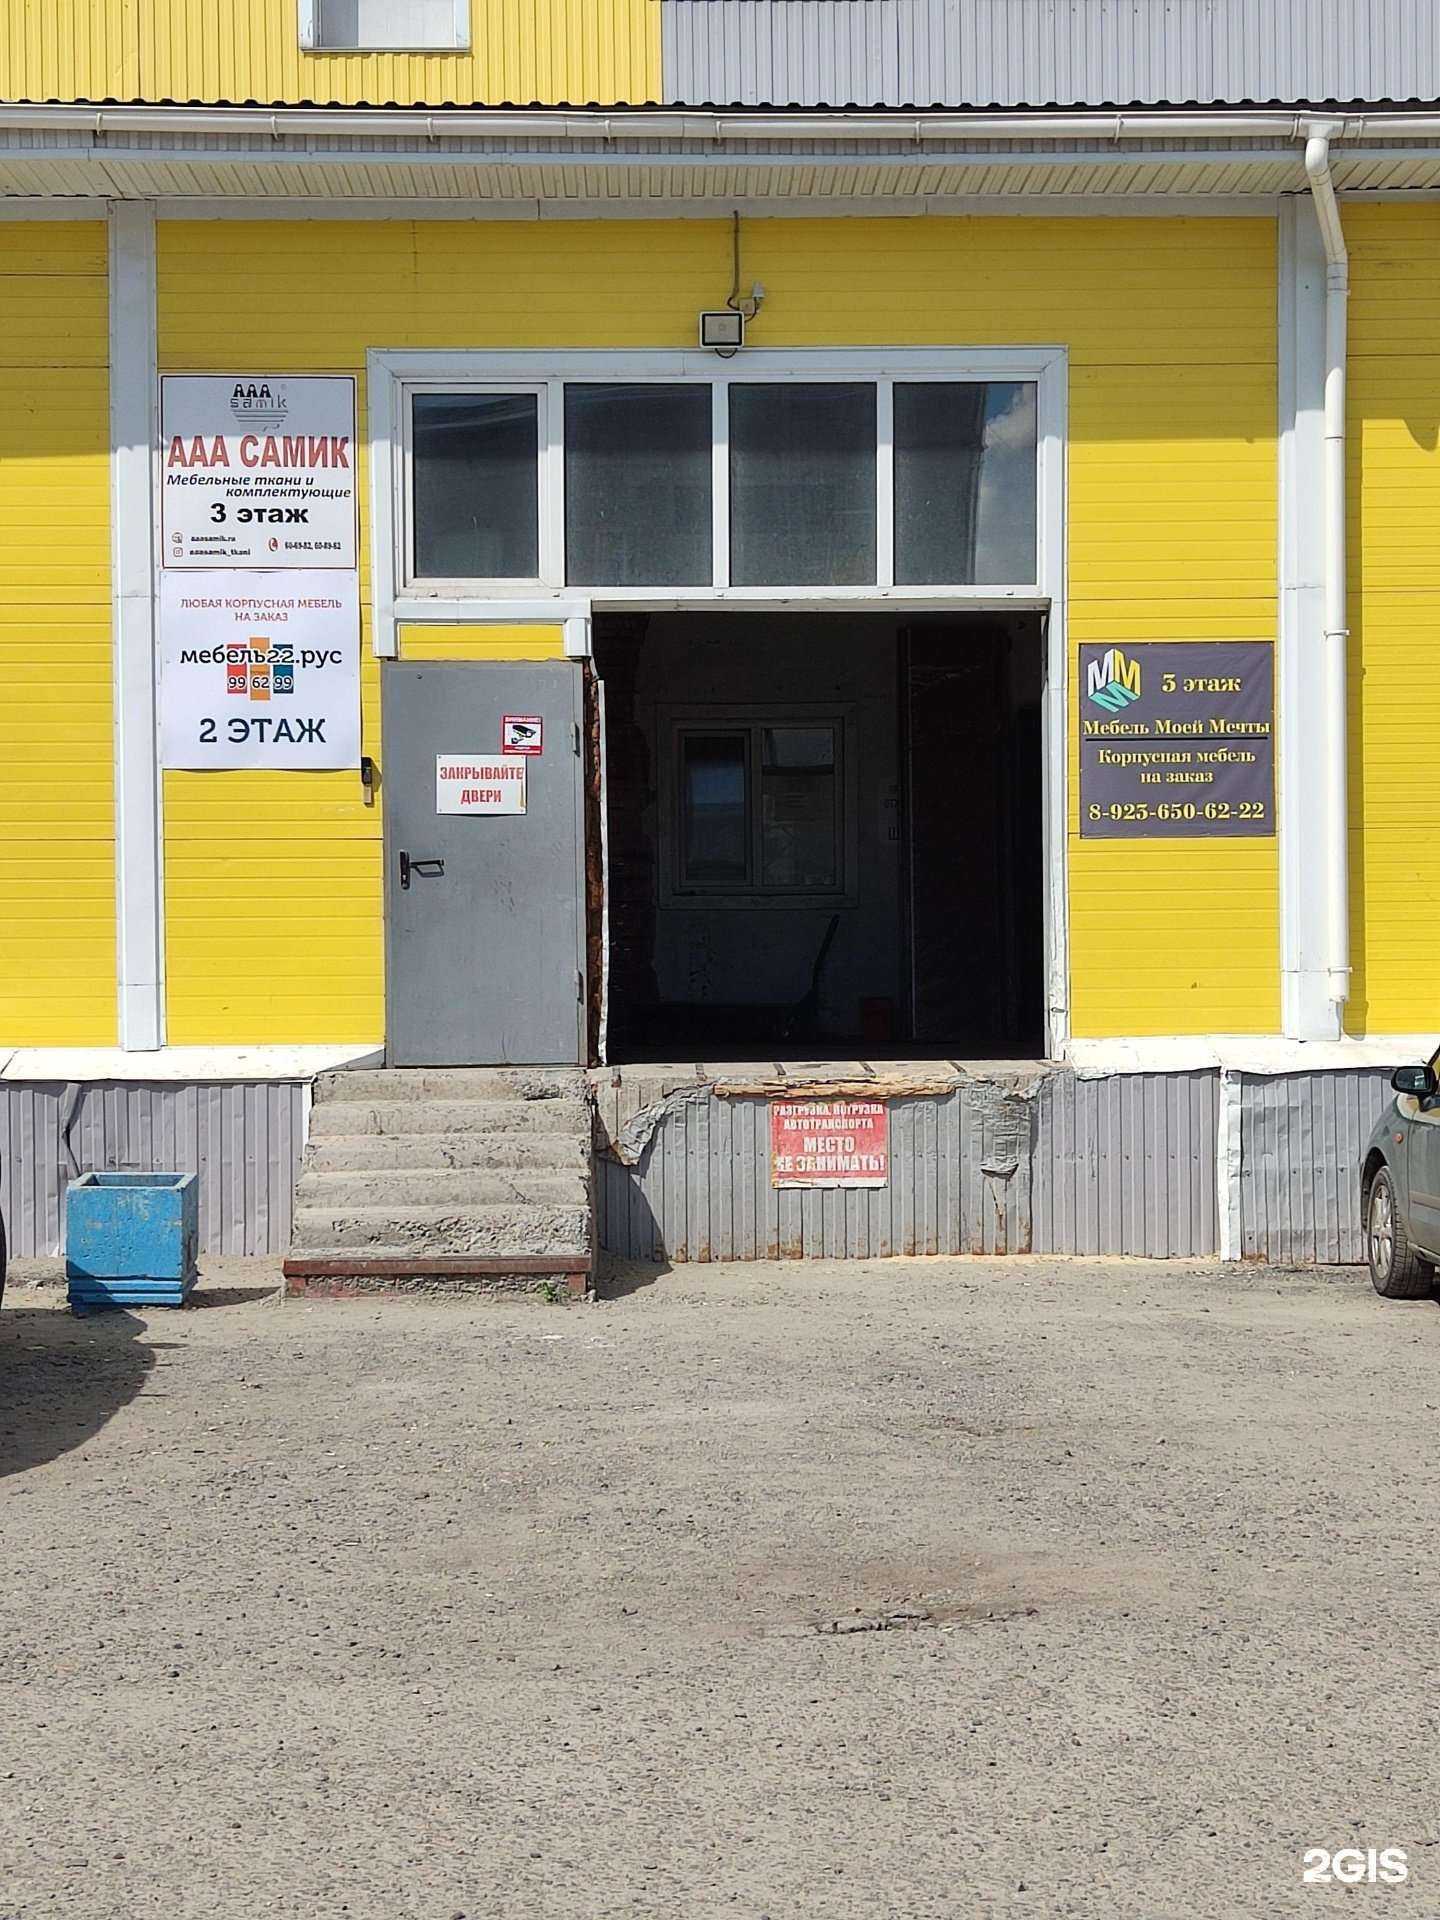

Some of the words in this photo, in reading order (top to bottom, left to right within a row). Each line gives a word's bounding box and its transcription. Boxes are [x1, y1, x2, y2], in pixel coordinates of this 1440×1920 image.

[230, 395, 288, 408] samik
[167, 435, 230, 468] ААА
[240, 434, 350, 468] САМИК
[166, 474, 250, 486] Мебельные
[254, 476, 302, 486] ткани
[305, 477, 314, 486] и
[226, 487, 351, 499] комплектующие
[210, 503, 226, 523] 3
[237, 508, 309, 523] этаж
[180, 598, 222, 609] ЛЮБАЯ
[225, 599, 294, 609] КОРПУСНАЯ
[297, 599, 342, 609] МЕБЕЛЬ
[234, 612, 251, 622] НА
[254, 612, 288, 622] ЗАКАЗ
[180, 645, 343, 669] мебель22.рус
[228, 676, 246, 689] 99
[252, 676, 270, 689] 62
[274, 676, 293, 689] 99
[1162, 672, 1176, 693] 3
[1184, 676, 1242, 692] этаж
[199, 718, 218, 743] 2
[227, 718, 326, 744] ЭТАЖ
[1083, 720, 1150, 735] Мебель
[1155, 719, 1204, 734] Моей
[1209, 719, 1270, 734] Мечты
[1098, 749, 1192, 767] Корпусная
[1197, 747, 1256, 763] мебель
[440, 765, 524, 780] ЗАКРЫВАЙТЕ
[1140, 773, 1162, 784] на
[1166, 771, 1214, 784] заказ
[460, 789, 502, 805] ДВЕРИ
[1089, 802, 1265, 821] 8-923-650-62-22
[783, 1118, 874, 1130] АВТОТРАНСПОРТА
[803, 1136, 855, 1153] МЕСТО
